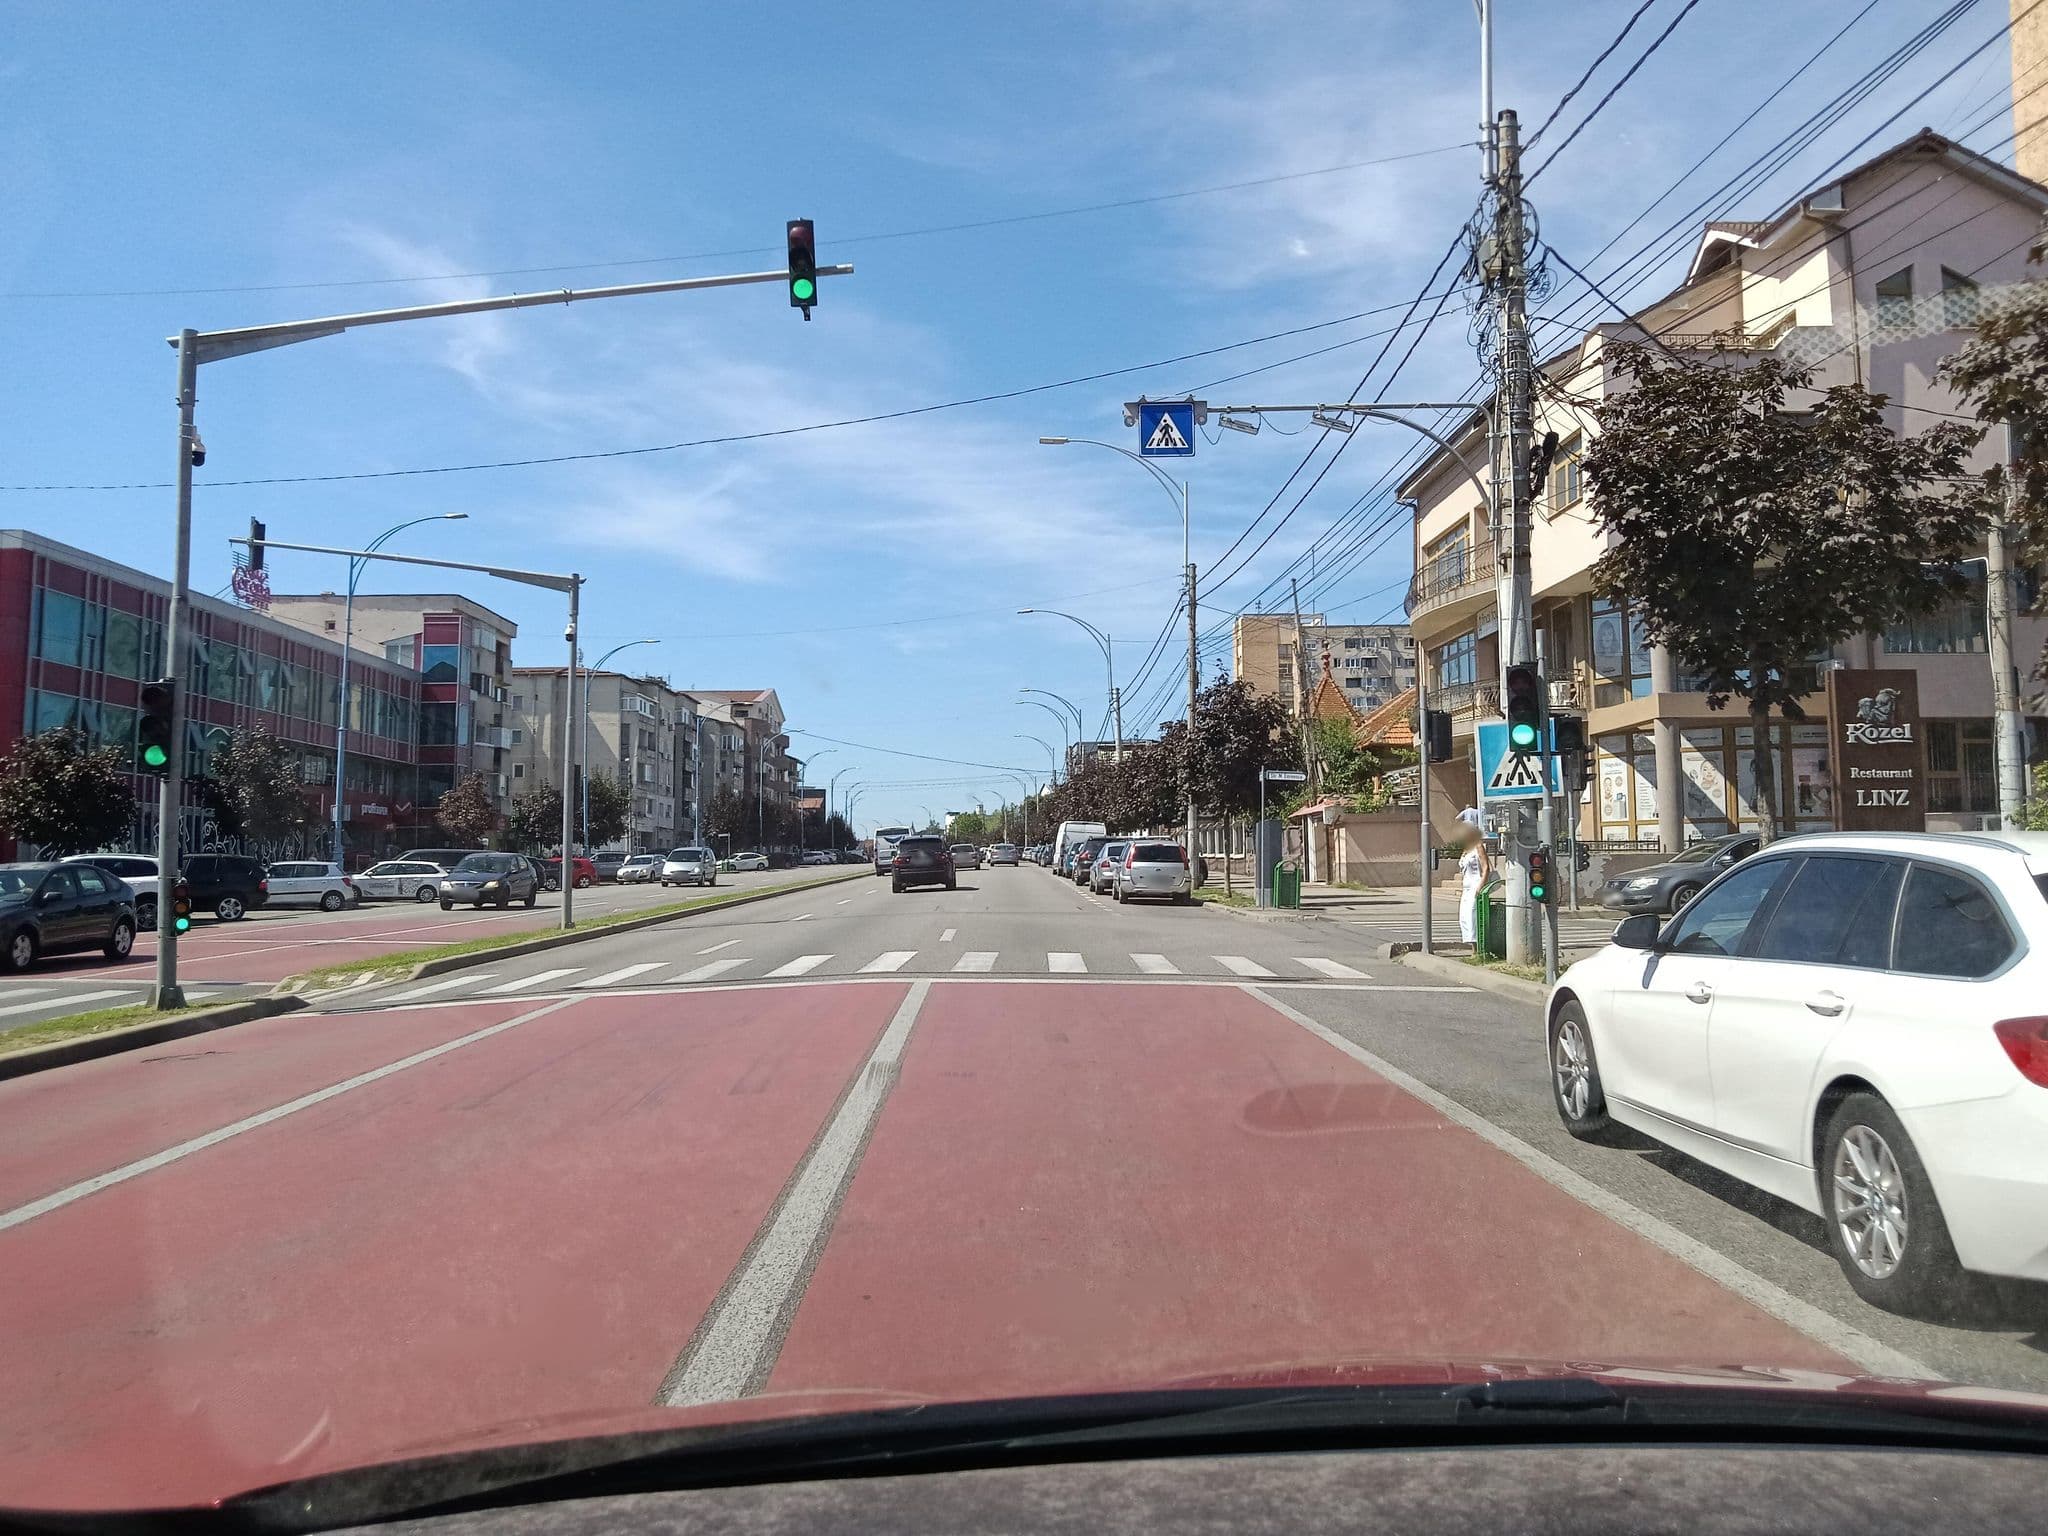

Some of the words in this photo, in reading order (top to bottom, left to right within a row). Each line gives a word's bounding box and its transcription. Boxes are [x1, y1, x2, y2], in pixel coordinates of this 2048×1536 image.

[1845, 723, 1913, 744] Kozel
[1850, 767, 1913, 778] Restaurant
[1856, 789, 1910, 806] LINZ
